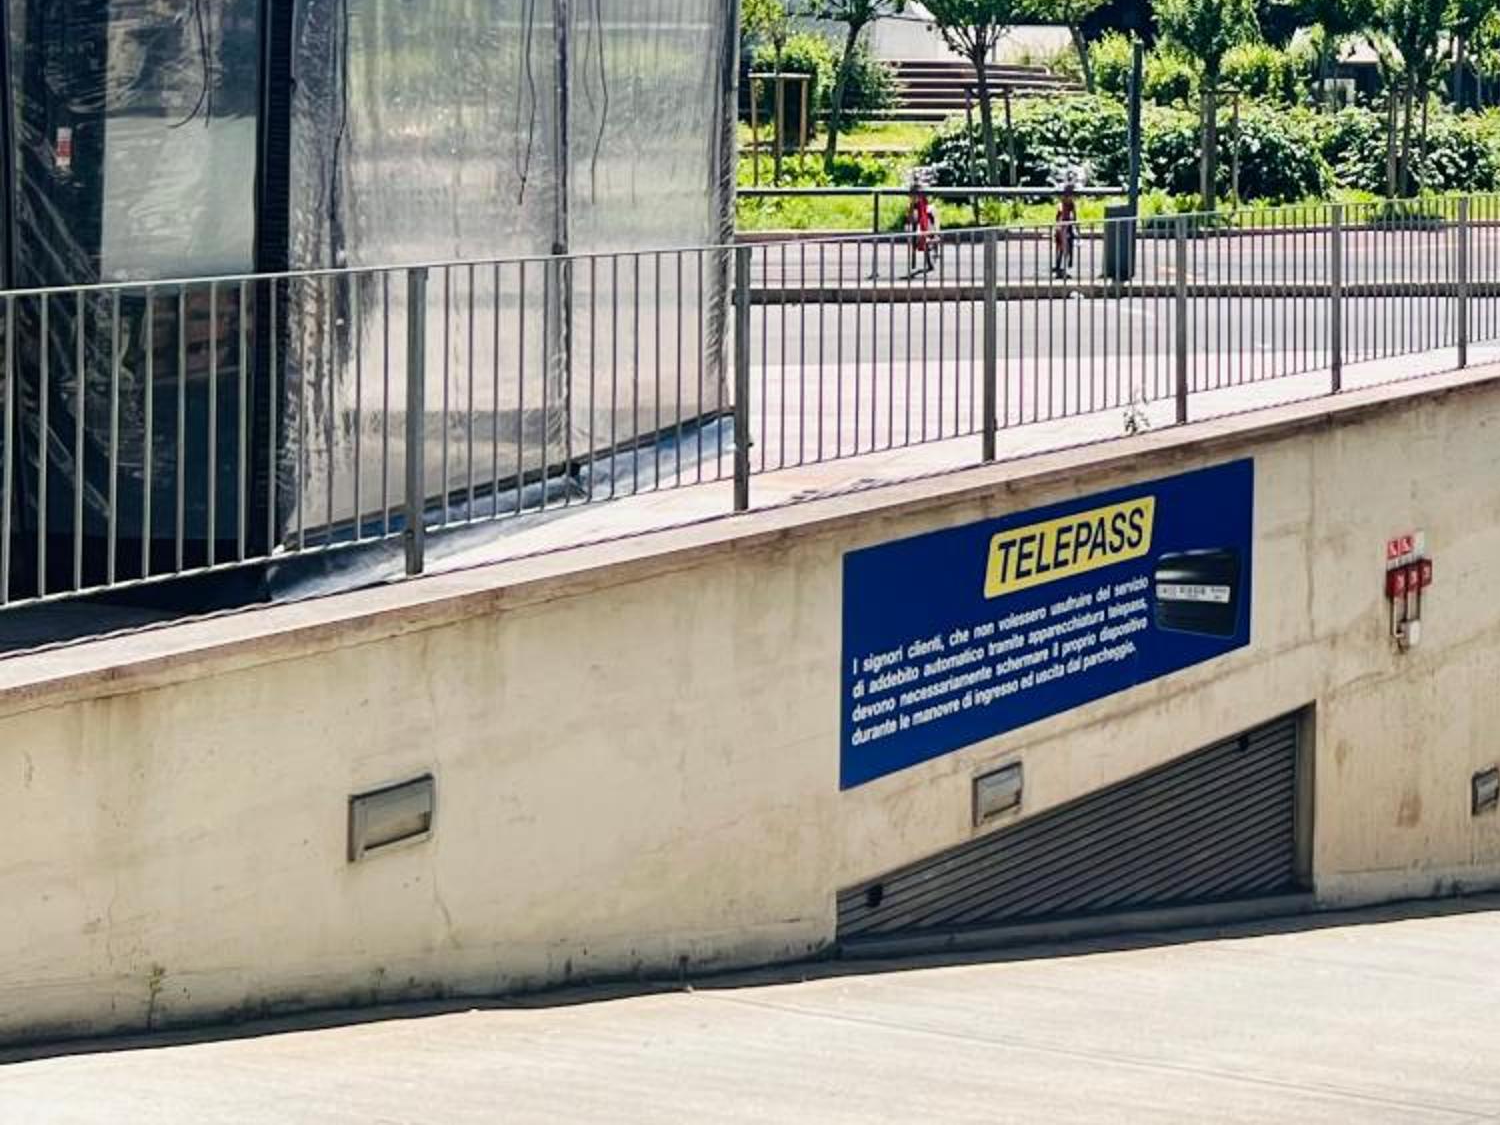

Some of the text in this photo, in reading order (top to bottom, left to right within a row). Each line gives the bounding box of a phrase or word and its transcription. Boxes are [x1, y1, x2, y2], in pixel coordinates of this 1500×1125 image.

[998, 506, 1145, 584] TELEPASS
[852, 679, 865, 699] di
[869, 665, 919, 693] addebito
[923, 646, 985, 677] automatico
[988, 633, 1025, 656] tramite
[1028, 610, 1105, 645] apparecchiatura
[863, 646, 903, 672] signori
[907, 635, 945, 659] clienti,
[949, 628, 970, 647] che
[973, 622, 995, 639] non
[998, 607, 1047, 631] volessero
[1050, 592, 1093, 616] usufruire
[1095, 584, 1111, 602] del
[1114, 574, 1149, 597] servizio
[851, 719, 897, 746] durante
[899, 714, 911, 730] le
[912, 698, 961, 726] manovre
[962, 690, 973, 710] di
[974, 680, 1019, 707] ingresso
[1020, 670, 1034, 690] ed
[1035, 663, 1065, 684] uscita
[852, 696, 896, 722] devono
[899, 665, 993, 707] necessariamente
[996, 648, 1049, 676] schermare
[1061, 631, 1097, 658] proprio
[1099, 616, 1148, 642] dispositivo
